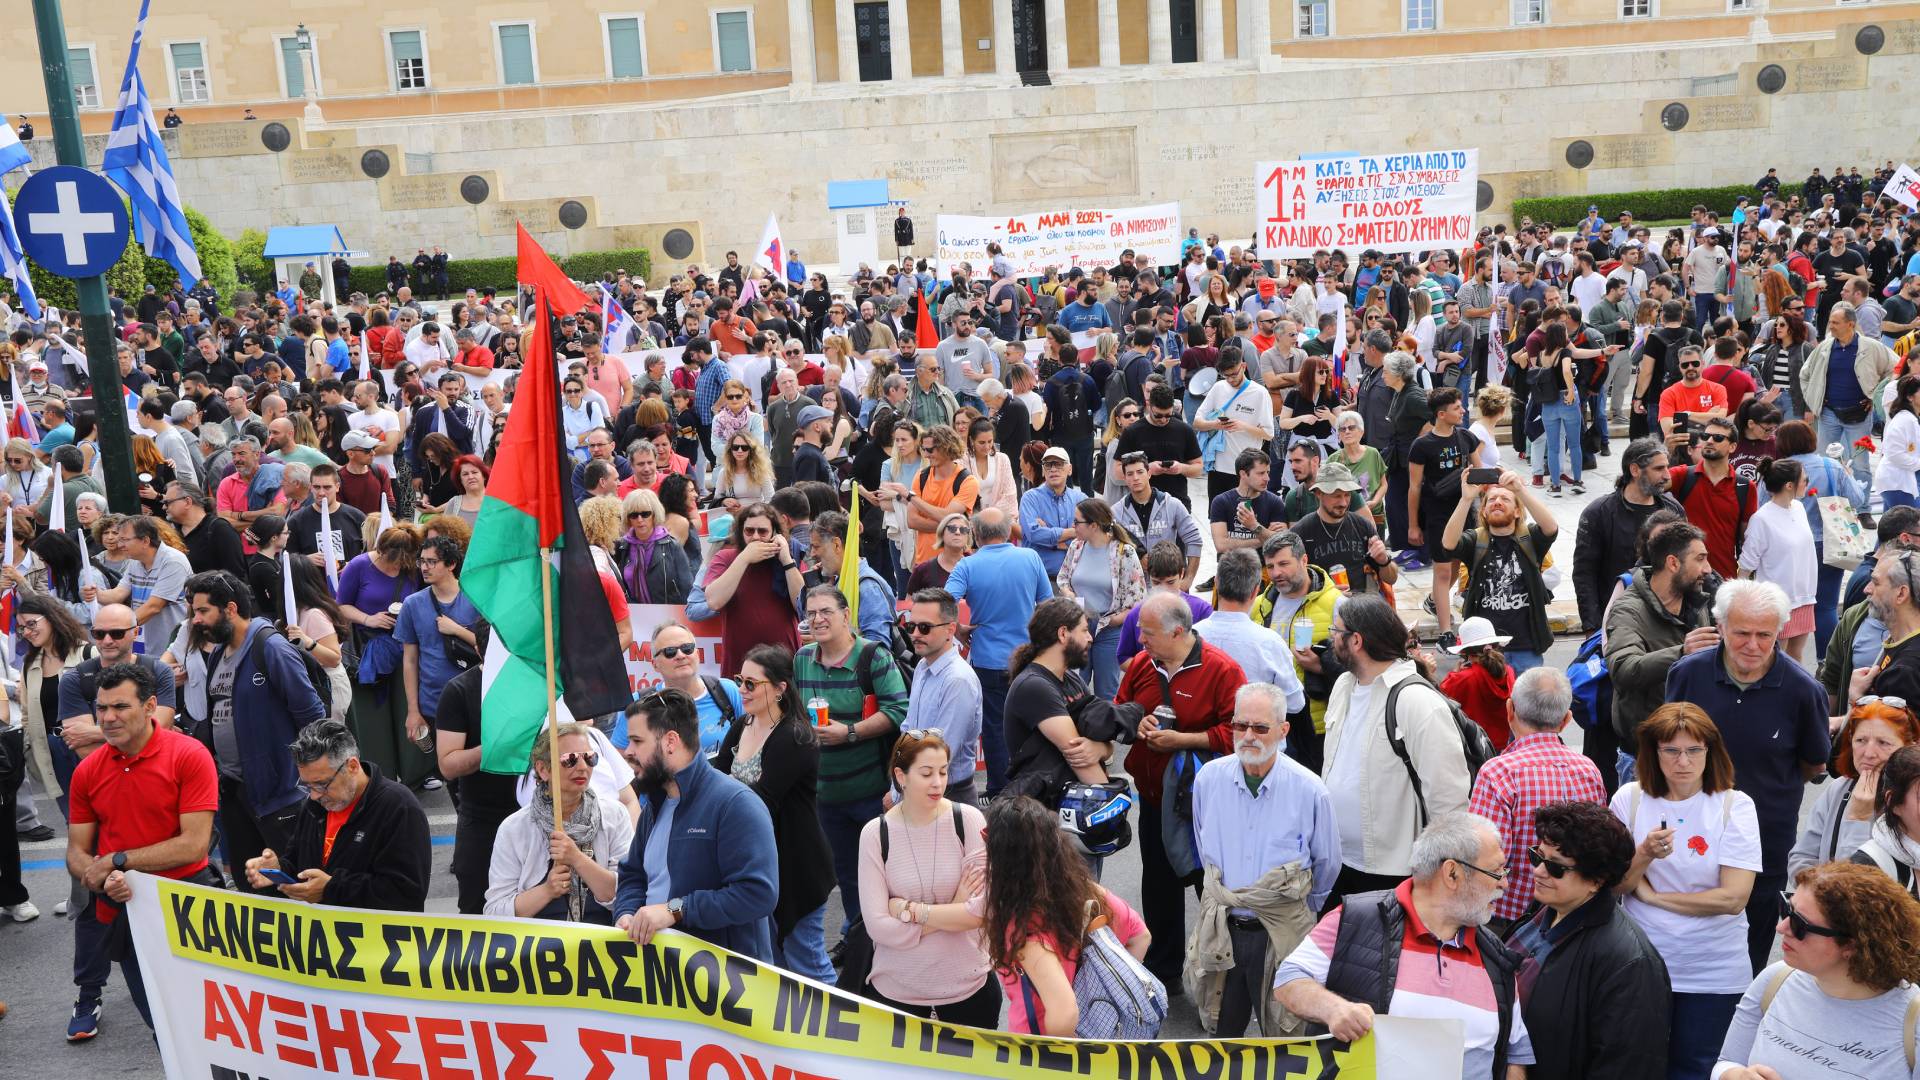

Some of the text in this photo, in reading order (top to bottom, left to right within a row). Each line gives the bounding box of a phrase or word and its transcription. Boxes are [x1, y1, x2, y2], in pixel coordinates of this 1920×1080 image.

[1359, 158, 1379, 174] ΤΑ
[1385, 154, 1423, 172] ΧΕΡΙΑ
[1425, 154, 1448, 170] ΑΠΟ
[1451, 151, 1466, 169] ΤΟ
[1358, 176, 1364, 187] &
[1366, 173, 1383, 187] ΤΙΣ
[1404, 183, 1447, 197] ΜΙΣΘΟΥΣ
[1343, 198, 1424, 218] ΓΙΑ ΟΛΟΥΣ
[1038, 212, 1071, 230] ΜΑΗ
[1076, 211, 1103, 225] 2024
[1110, 222, 1125, 237] ΘΑ
[1266, 223, 1333, 249] ΚΛΑΔΙΚΟ
[171, 893, 367, 983] ΚΑΝΕΝΑΣ
[380, 924, 758, 1027] ΣΥΜΒΙΒΑΣΜΟΣ
[772, 975, 861, 1042] ΜΕ
[203, 979, 553, 1080] ΑΥΞΗΣΕΙΣ
[1836, 1041, 1888, 1061] start
